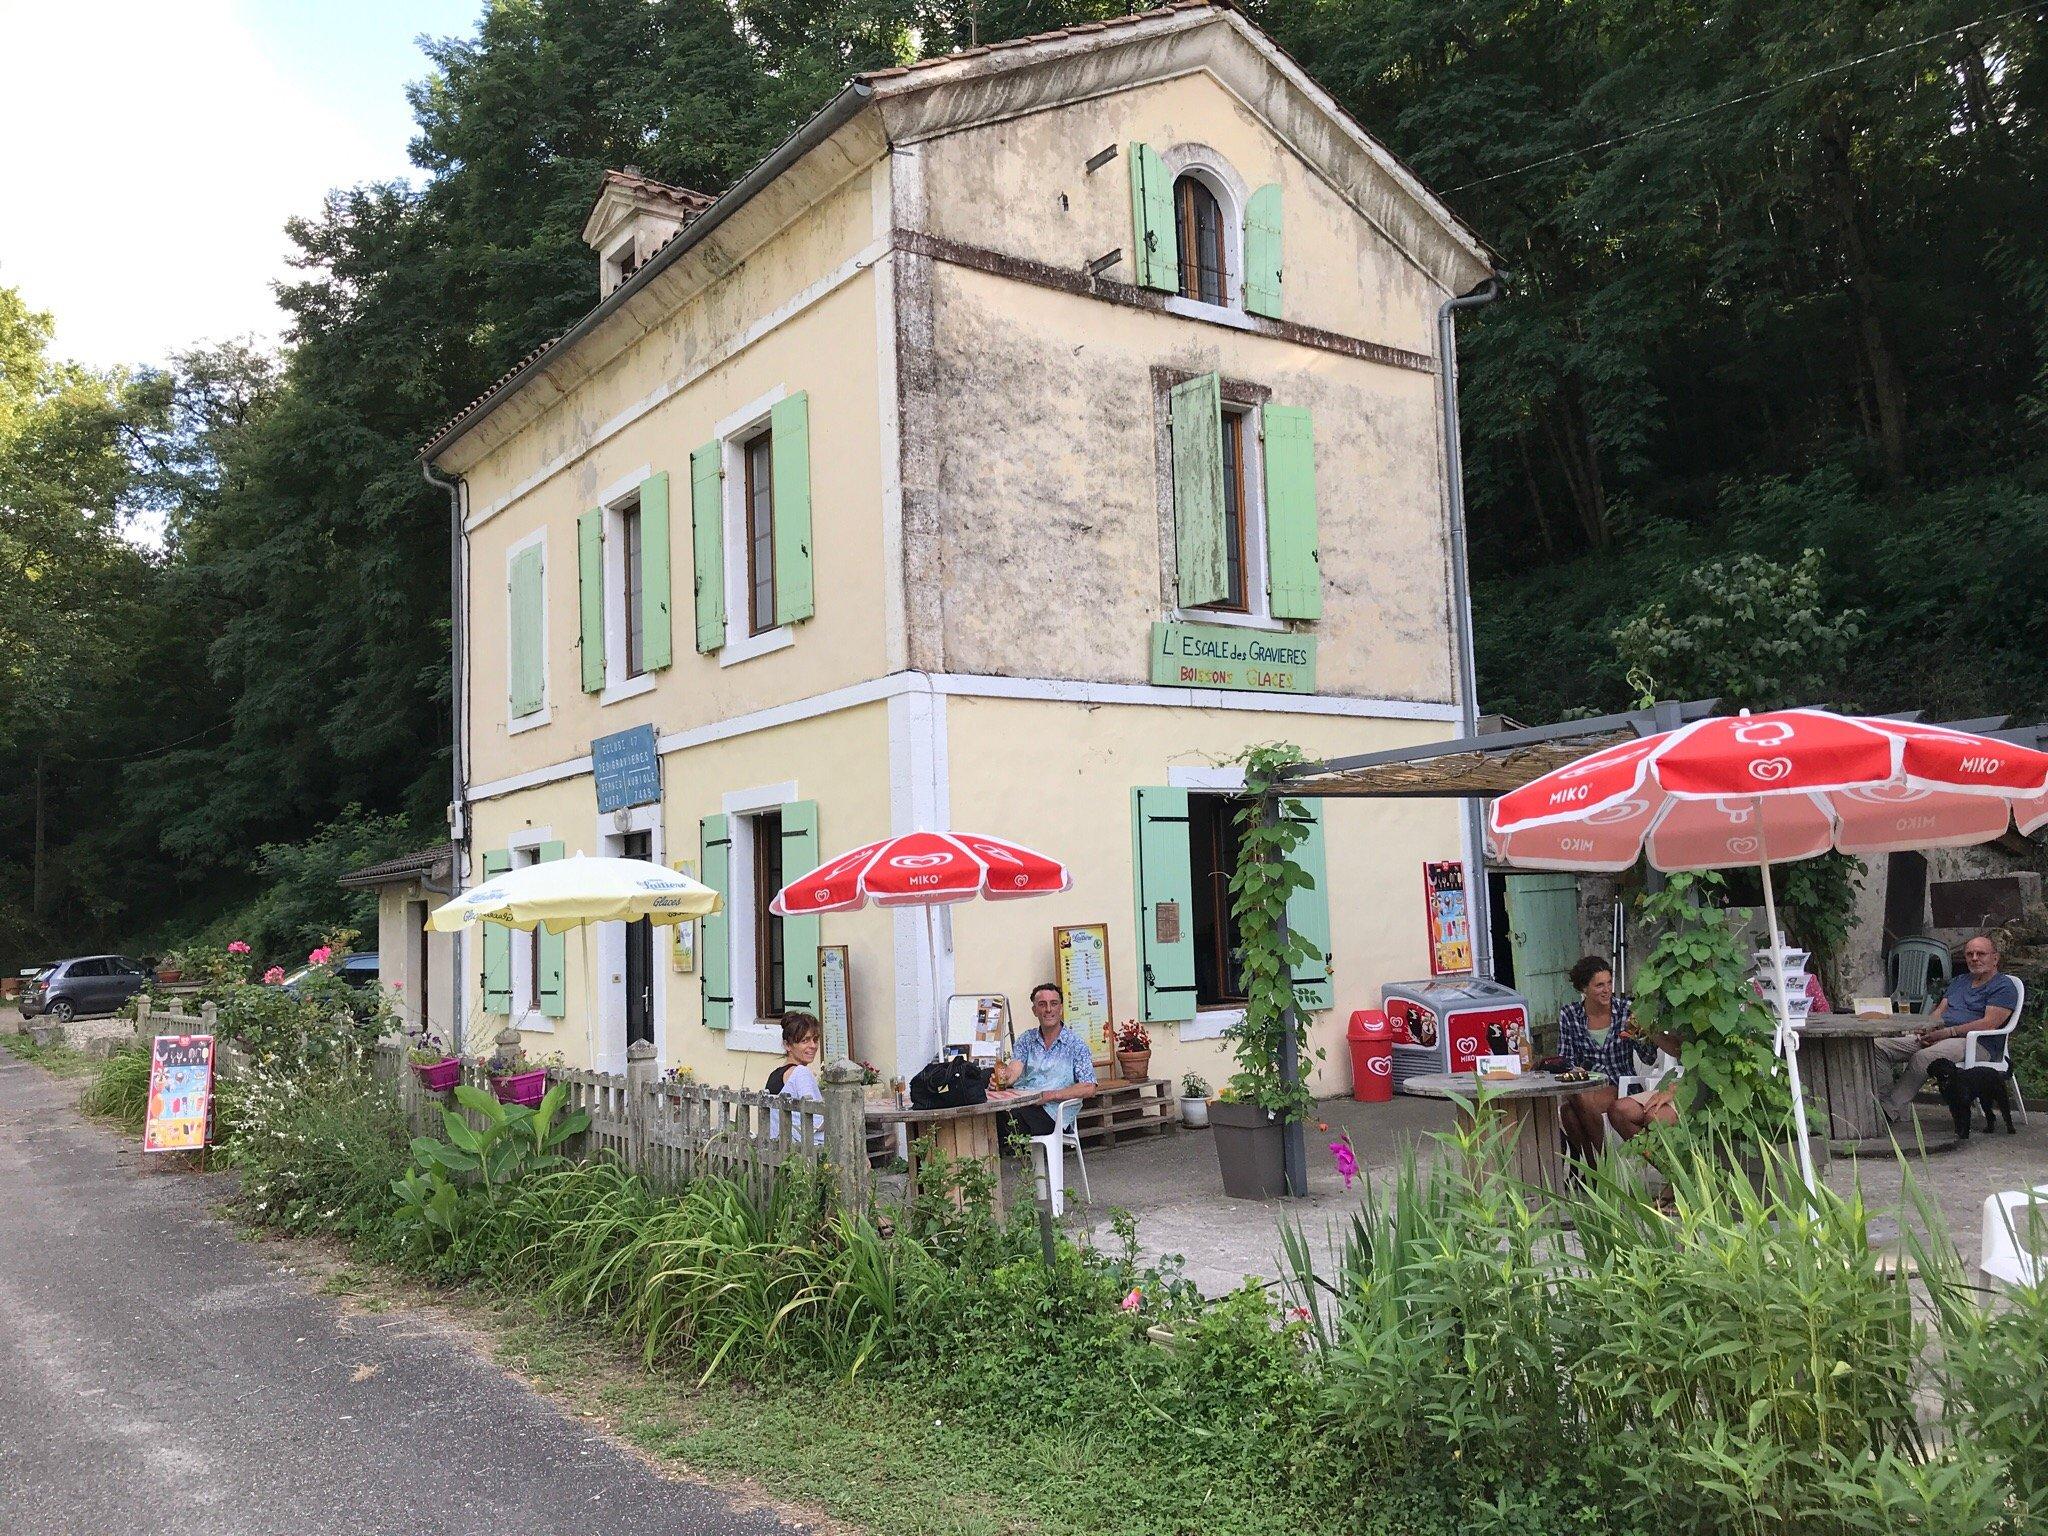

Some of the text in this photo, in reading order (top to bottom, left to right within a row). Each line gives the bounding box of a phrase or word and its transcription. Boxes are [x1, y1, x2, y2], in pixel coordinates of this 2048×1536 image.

[1230, 647, 1247, 661] des
[1180, 666, 1293, 688] BOISSONS GLACES
[1958, 757, 2000, 774] MIKO
[1549, 785, 1589, 805] MIKO
[909, 875, 939, 886] MIKO
[653, 896, 682, 907] Glaces
